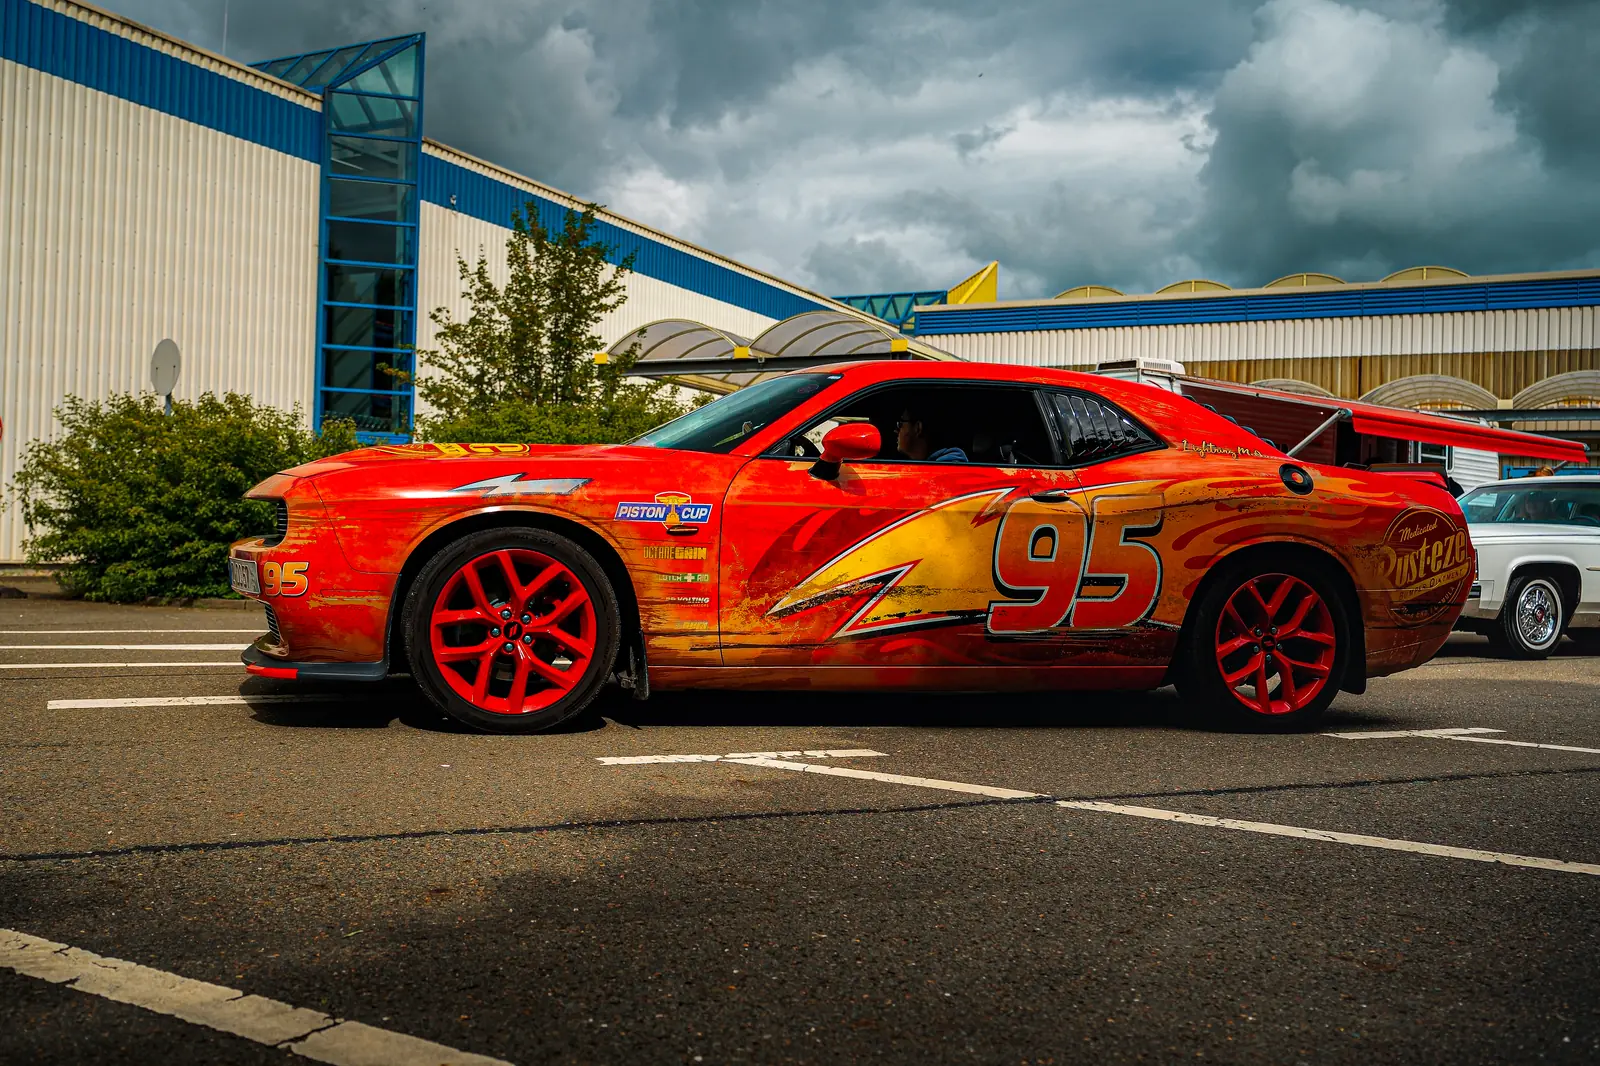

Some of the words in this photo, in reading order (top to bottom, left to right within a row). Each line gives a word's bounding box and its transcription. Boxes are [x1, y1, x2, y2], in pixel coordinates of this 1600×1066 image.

[618, 506, 666, 518] PISTON
[682, 507, 708, 519] CUP
[1399, 518, 1438, 542] Medicated
[263, 561, 309, 597] 95
[656, 573, 682, 582] LUTCH
[986, 493, 1164, 641] 95
